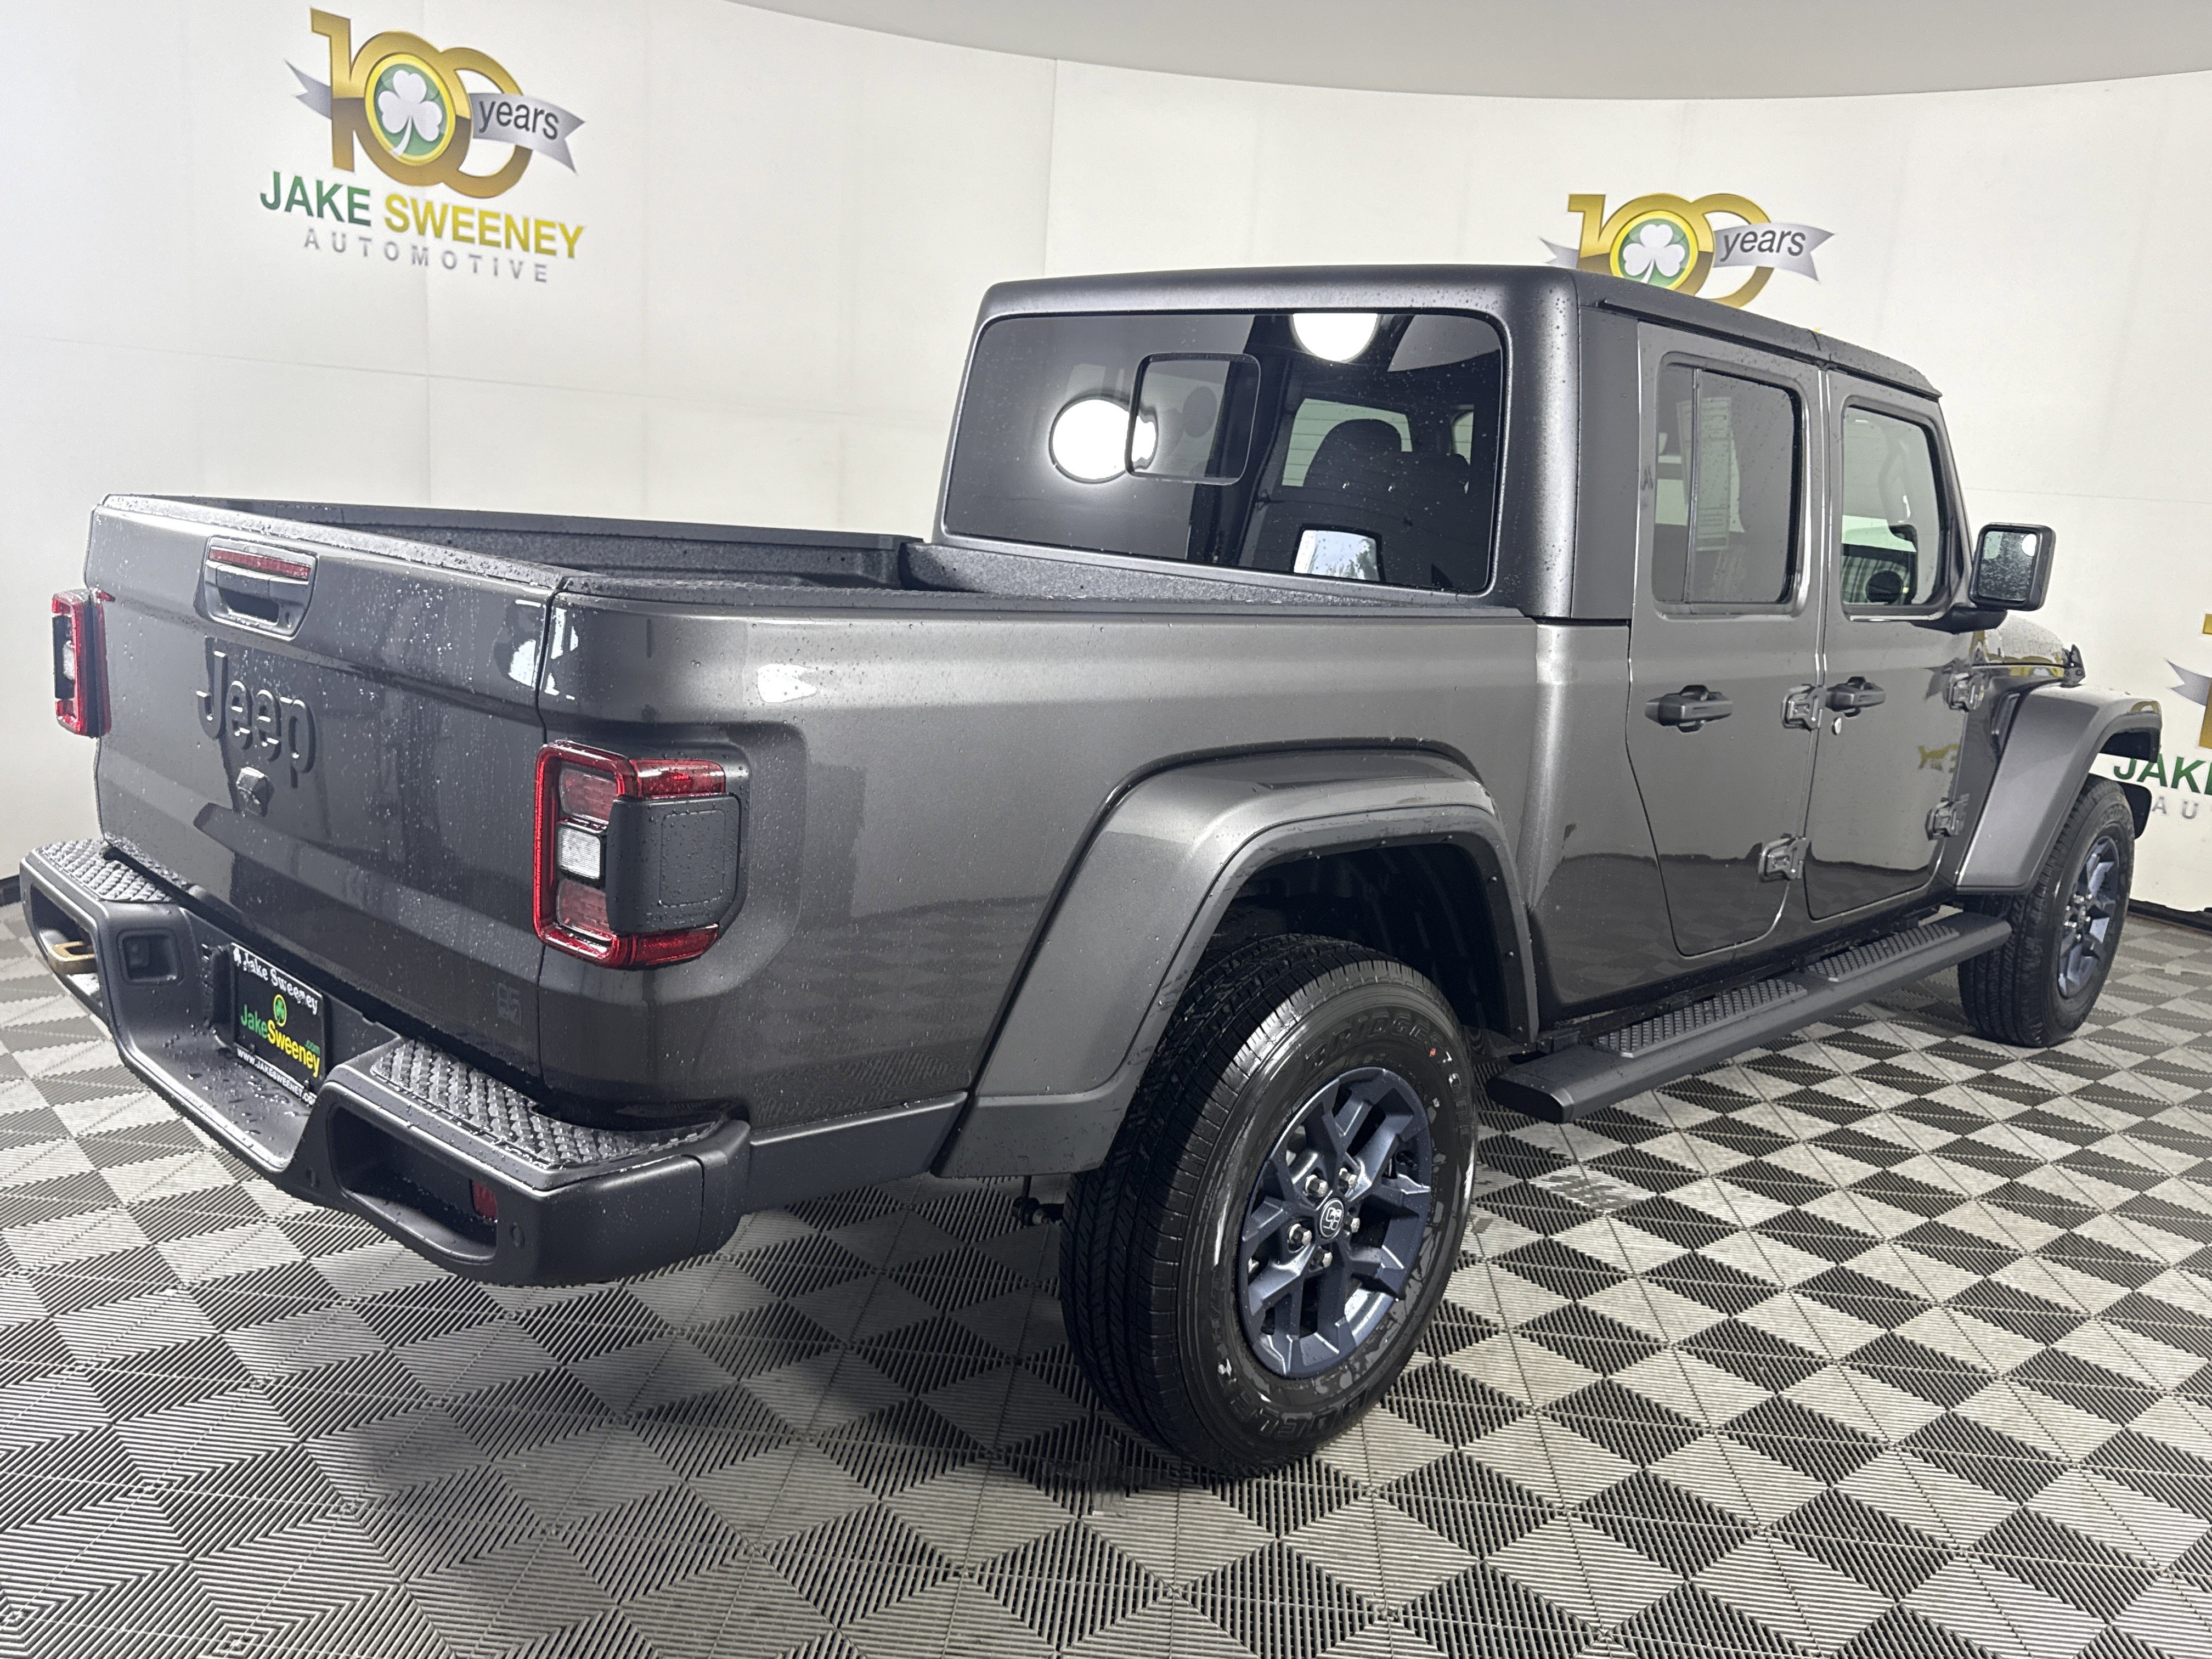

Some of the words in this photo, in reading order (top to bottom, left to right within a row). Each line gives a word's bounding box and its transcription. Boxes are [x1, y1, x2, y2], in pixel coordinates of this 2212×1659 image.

[310, 7, 533, 199] 100
[478, 99, 559, 140] years
[260, 171, 371, 227] JAKE
[385, 193, 585, 259] SWEENEY
[1720, 229, 1806, 262] years
[303, 228, 548, 283] AUTOMOTIVE
[196, 650, 314, 788] Jeep
[243, 952, 268, 981] Jake
[270, 968, 318, 1015] Sweeney
[1304, 1012, 1470, 1154] BRIDGESTONE
